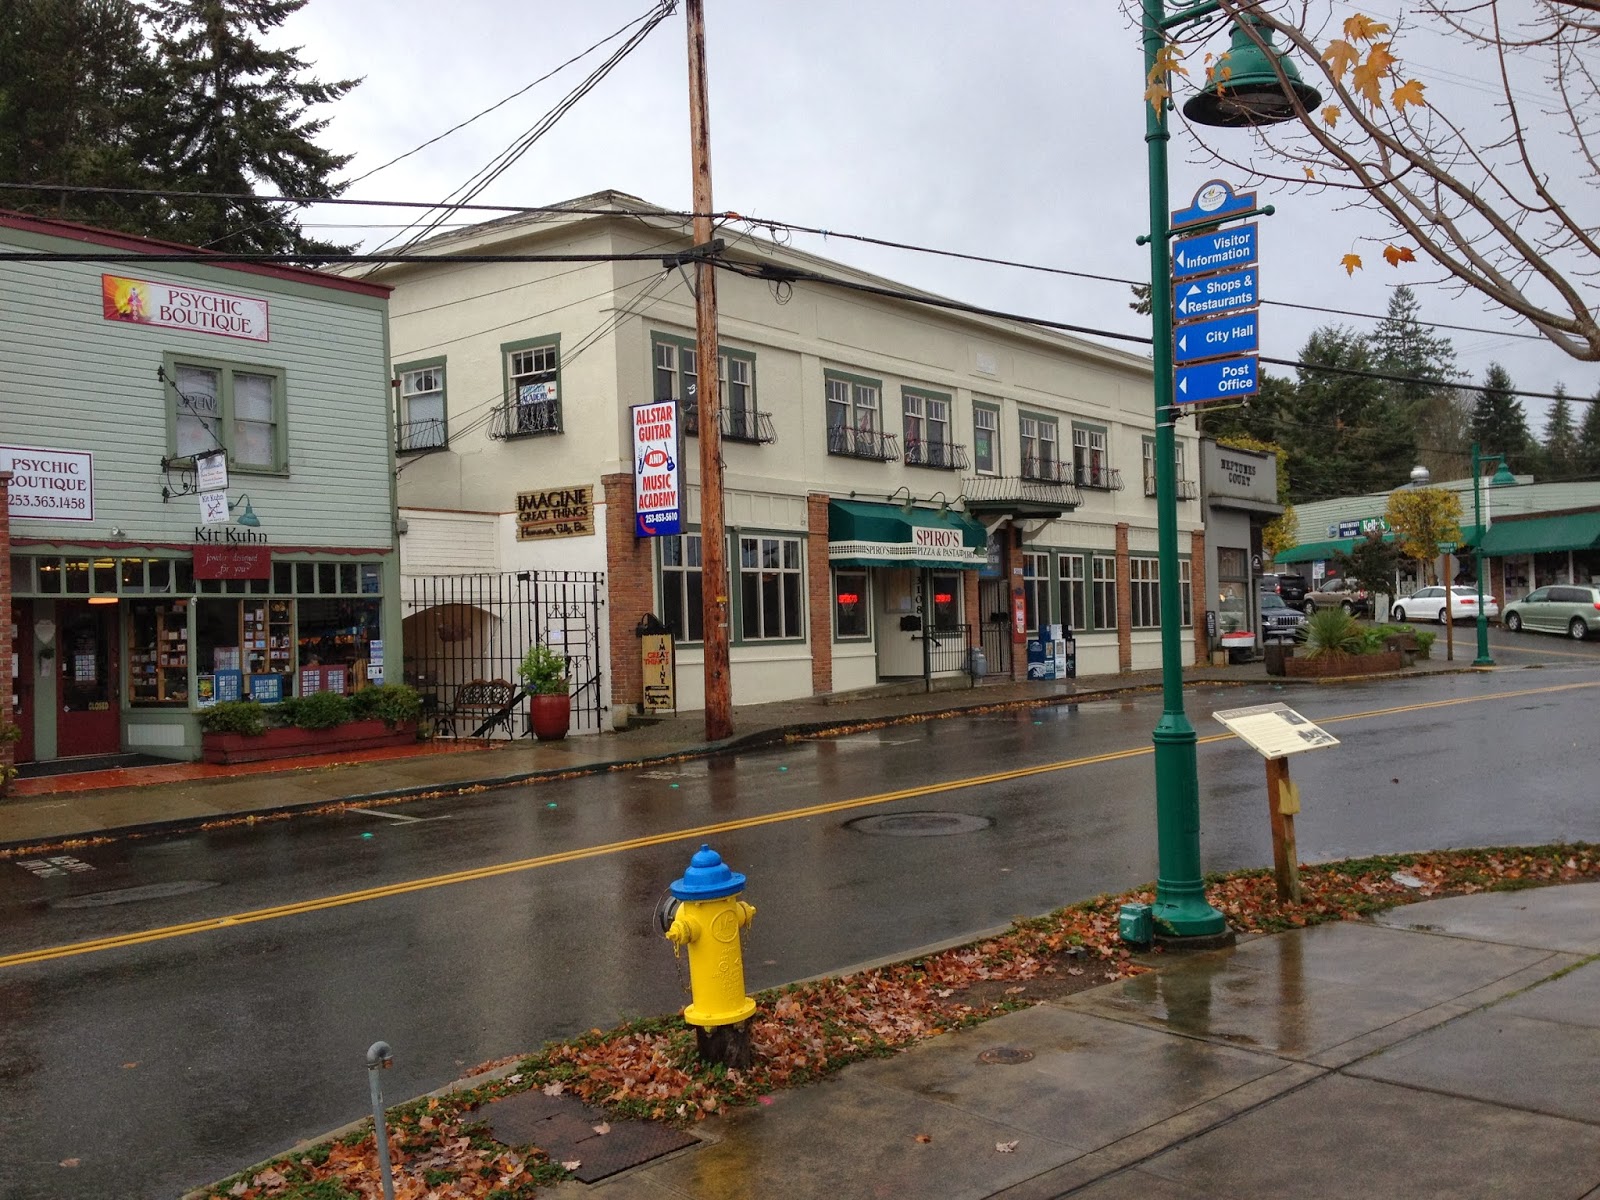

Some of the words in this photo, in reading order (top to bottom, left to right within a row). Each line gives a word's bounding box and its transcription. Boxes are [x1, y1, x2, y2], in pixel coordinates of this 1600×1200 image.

[1213, 234, 1250, 250] Visitor
[1186, 247, 1250, 269] Information
[1206, 279, 1241, 294] Shops
[1243, 275, 1253, 287] &
[168, 290, 243, 316] PSYCHIC
[1188, 292, 1253, 313] Restaurants
[159, 305, 253, 334] BOUTIQUE
[1206, 331, 1230, 343] City
[1232, 324, 1254, 339] Hall
[1222, 364, 1249, 378] Post
[1218, 379, 1253, 392] Office
[636, 405, 673, 425] ALLSTAR
[638, 424, 672, 442] GUITAR
[11, 458, 79, 475] PSYCHIC
[649, 453, 664, 464] AND
[1220, 459, 1256, 476] NEPTUNES
[642, 474, 672, 491] MUSIC
[1228, 472, 1251, 487] COURT
[8, 494, 86, 510] 253.363.1458
[517, 489, 588, 511] IMAGINE
[639, 491, 676, 509] ACADEMY
[519, 509, 549, 521] GREAT
[551, 506, 588, 519] THINGS
[645, 512, 678, 523] 253-853-5610
[195, 527, 221, 543] Kit
[226, 527, 268, 543] Kuhn
[916, 529, 960, 548] SPIRO'S
[865, 546, 890, 555] SPIRO'S
[917, 547, 936, 556] PIZZA
[936, 548, 942, 556] &
[942, 548, 961, 558] PASTA
[215, 563, 229, 578] for
